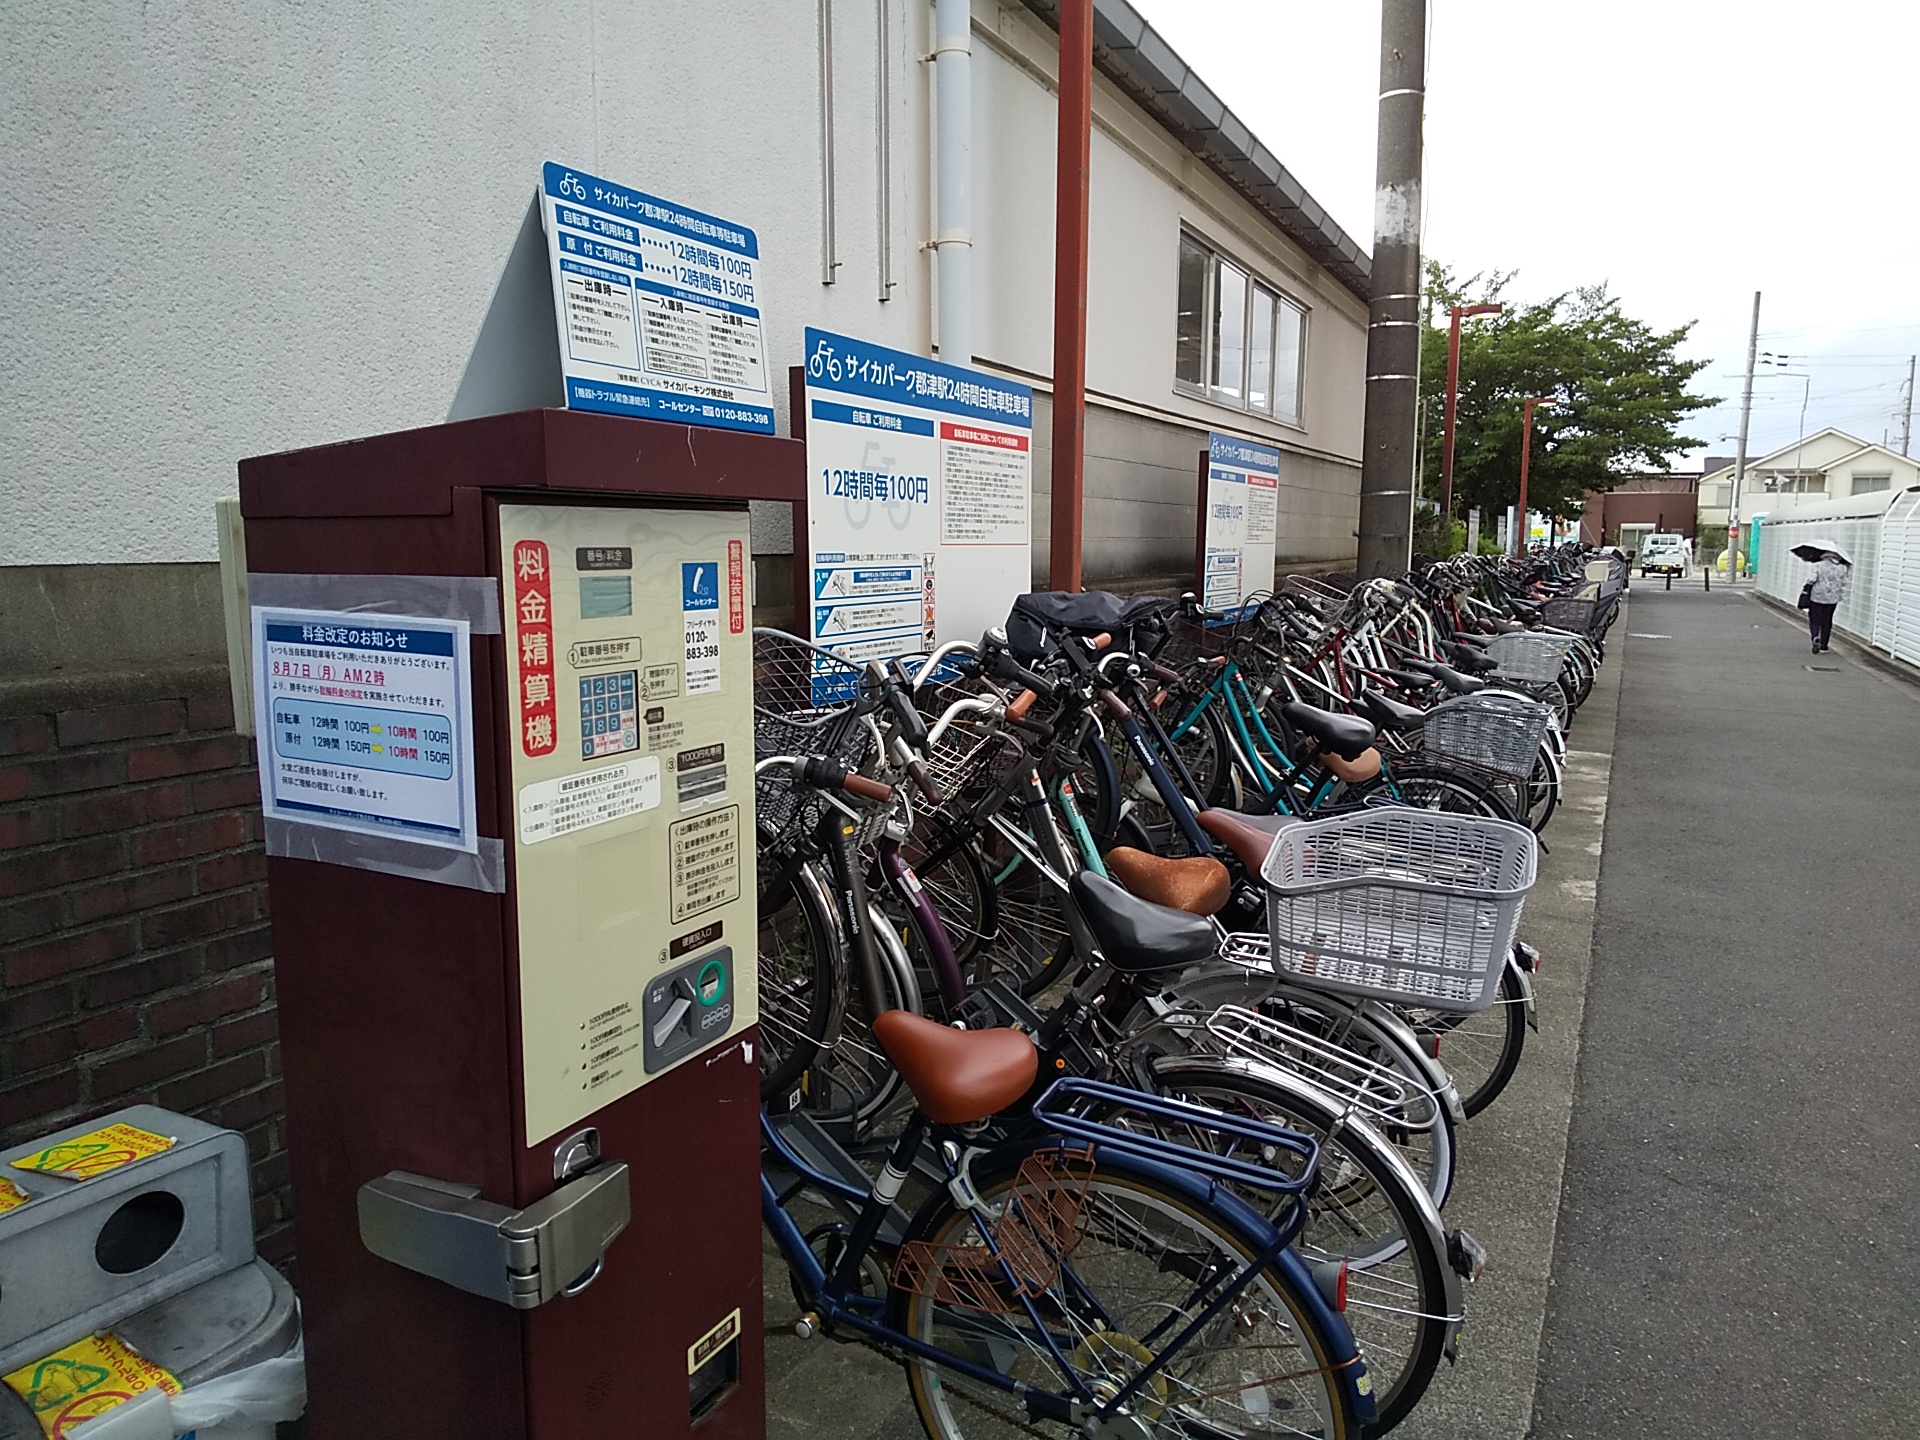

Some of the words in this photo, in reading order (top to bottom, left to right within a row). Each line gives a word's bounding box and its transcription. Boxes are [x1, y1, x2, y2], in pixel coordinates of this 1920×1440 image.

[563, 210, 591, 228] 自転車
[592, 218, 634, 242] ご利用料金
[670, 241, 752, 280] 12時間毎100円
[595, 245, 637, 267] ご利用料金
[673, 265, 754, 303] 12時間毎150円
[663, 380, 735, 400] サイカパーキング株式会社
[845, 354, 1030, 418] サイカパーク郡津駅24時間自転車駐車場
[658, 400, 701, 414] コールセンター
[714, 409, 769, 425] 0120-883-398
[852, 410, 871, 425] 自転車
[872, 413, 903, 430] ご利用料金
[823, 469, 928, 504] 12時間毎100円
[730, 543, 742, 630] 警報装置付
[686, 598, 717, 606] コールセンター
[686, 620, 717, 629] フリーダイヤル
[302, 626, 408, 648] 料金改定のお知らせ
[686, 631, 708, 644] 0120-
[517, 548, 552, 750] 料金精算機
[686, 645, 719, 660] 883-398
[595, 681, 603, 693] 2
[609, 679, 617, 691] 3
[582, 703, 590, 715] 4
[596, 701, 604, 712] 5
[610, 698, 617, 710] 6
[276, 712, 301, 726] 自転車
[311, 716, 339, 731] 12時間
[345, 720, 370, 734] 100円
[387, 726, 418, 740] 10時間
[423, 730, 449, 744] 100円
[583, 722, 591, 735] 7
[597, 720, 605, 732] 8
[610, 718, 618, 729] 9
[285, 732, 302, 745] 原付
[312, 736, 340, 751] 12時間
[345, 740, 371, 754] 150円
[388, 746, 418, 760] 10時間
[424, 750, 450, 765] 150円
[584, 742, 592, 754] 0
[1134, 735, 1155, 766] Panasonic
[845, 889, 860, 934] Panasonic
